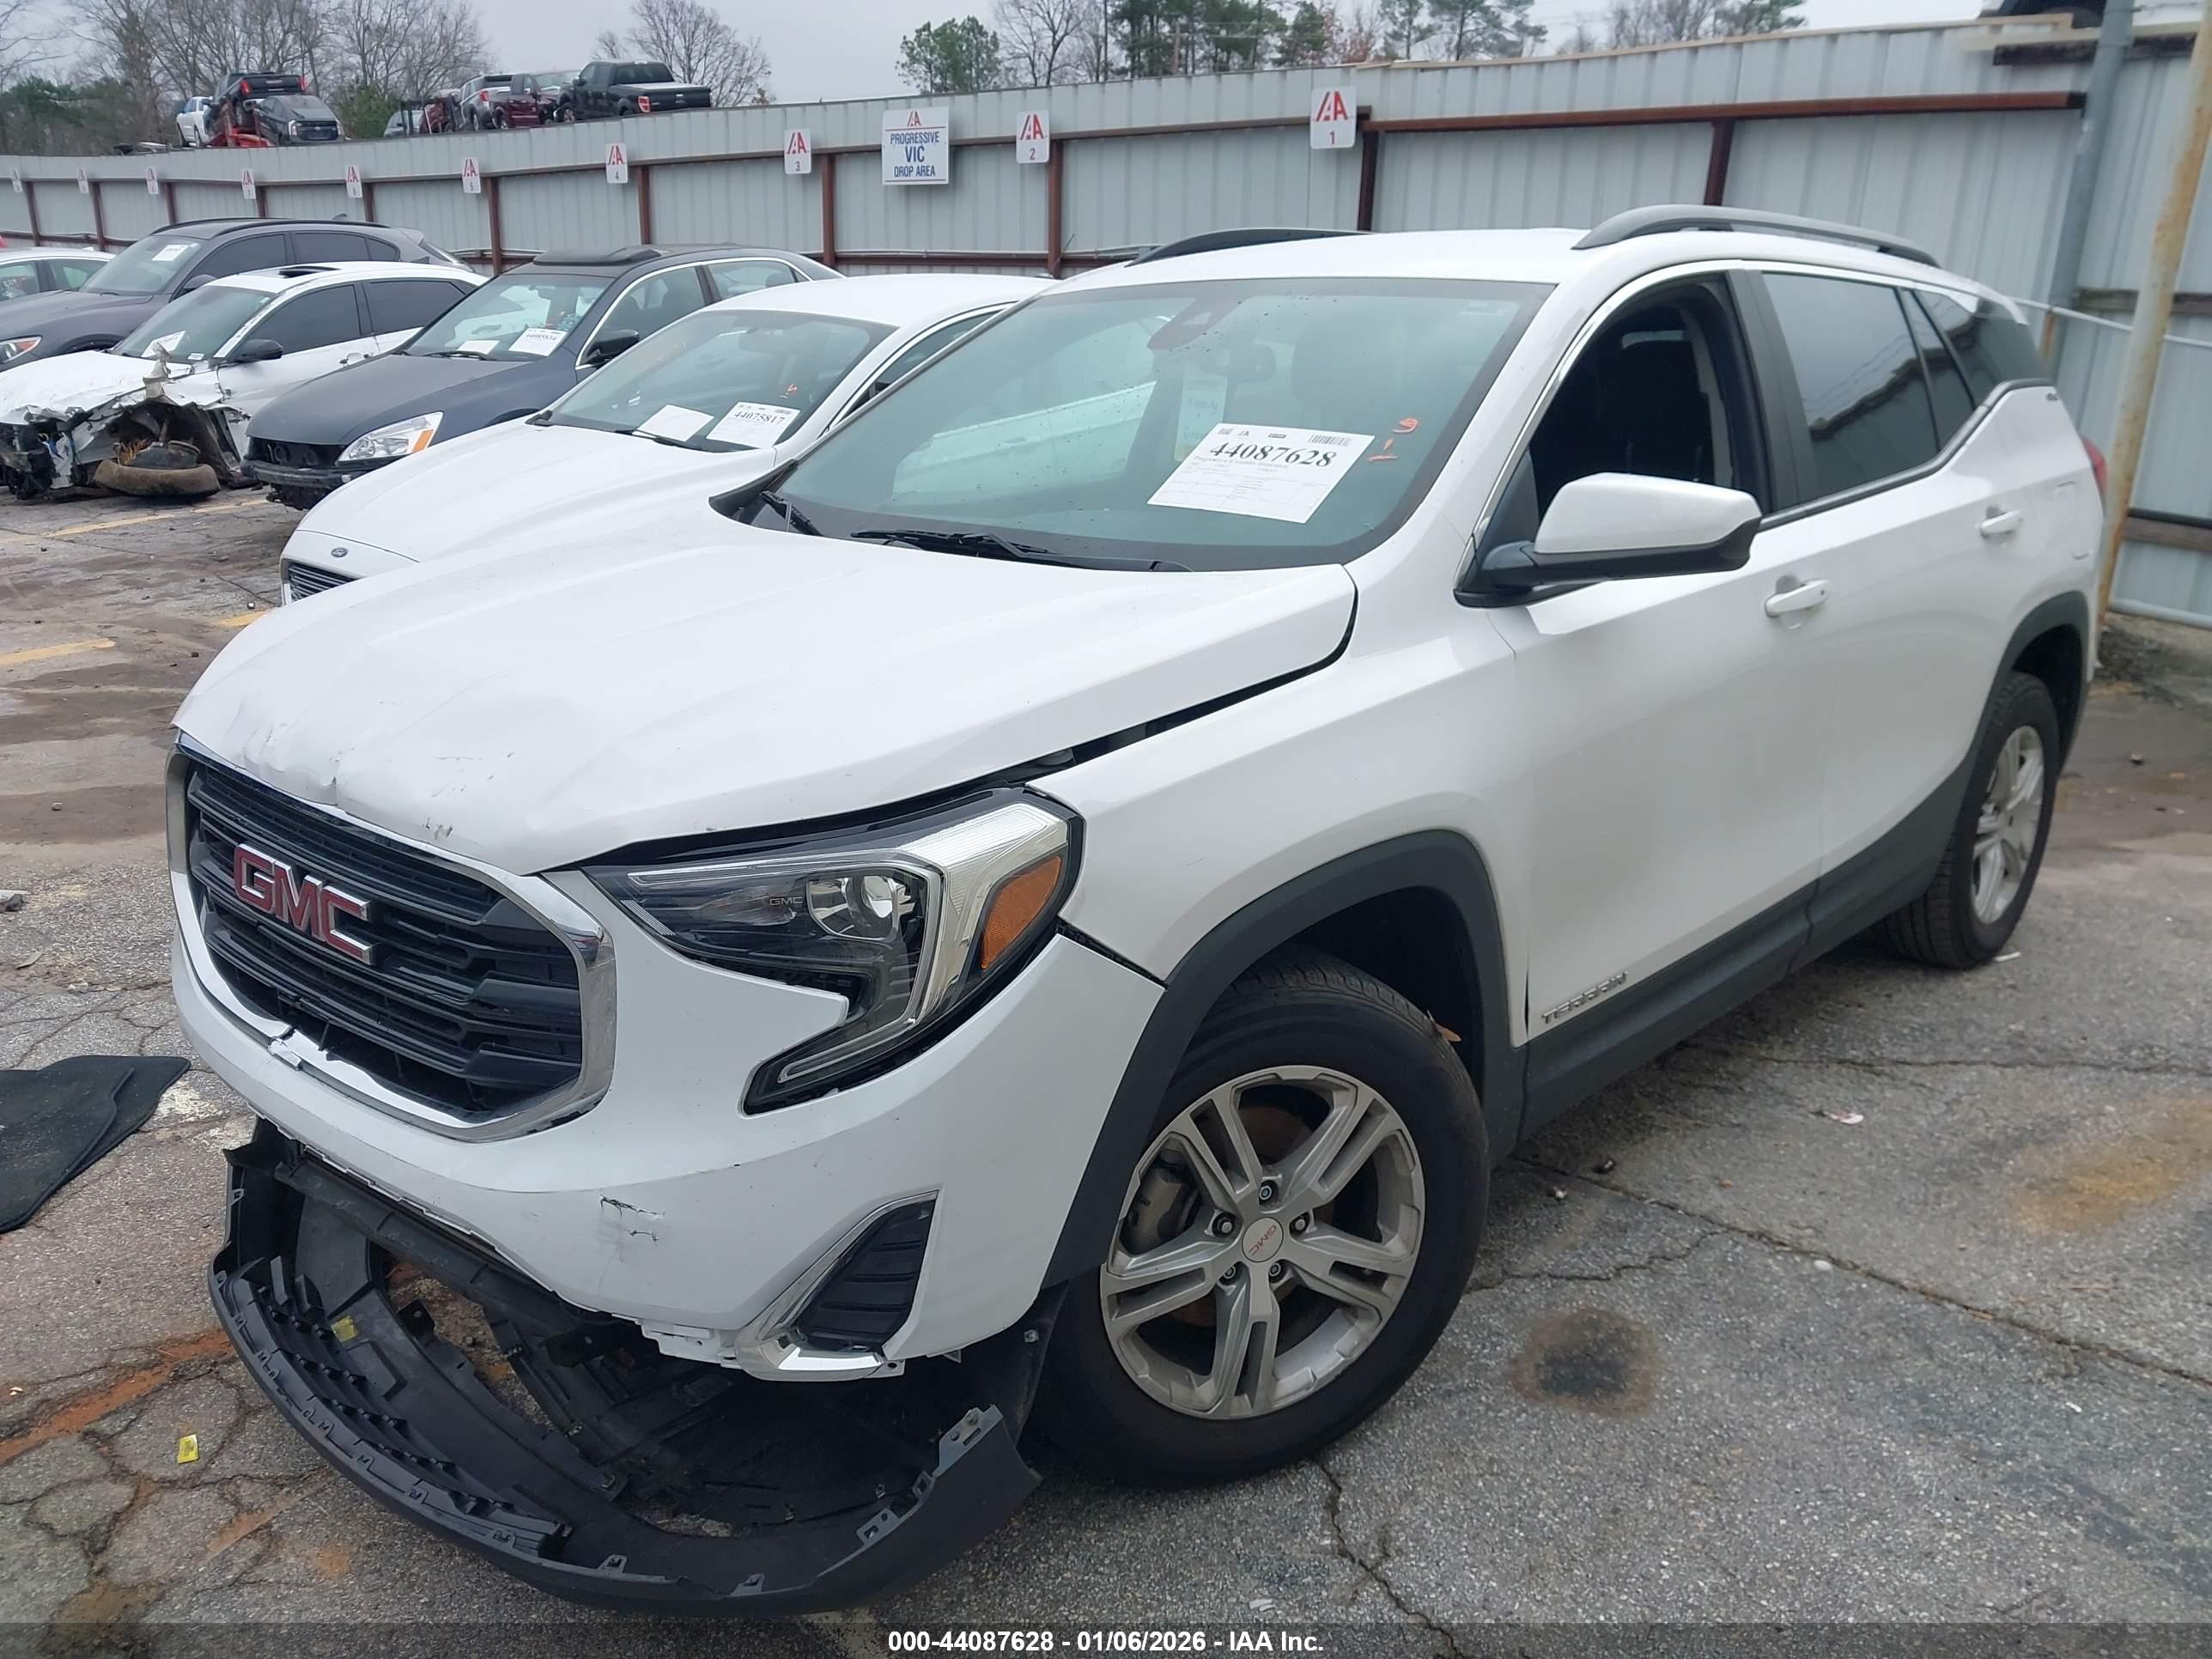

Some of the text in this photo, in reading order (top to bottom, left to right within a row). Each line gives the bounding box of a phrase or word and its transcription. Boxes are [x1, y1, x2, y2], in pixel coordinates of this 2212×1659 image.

[890, 131, 940, 145] PROGRESSIVE
[1329, 130, 1335, 145] 1
[904, 145, 926, 163] VIC
[1030, 147, 1036, 161] 2
[795, 161, 800, 172] 3
[894, 164, 936, 178] DROP AREA
[734, 411, 786, 424] 44075817
[1210, 441, 1337, 468] 44087628
[233, 843, 373, 965] GMC
